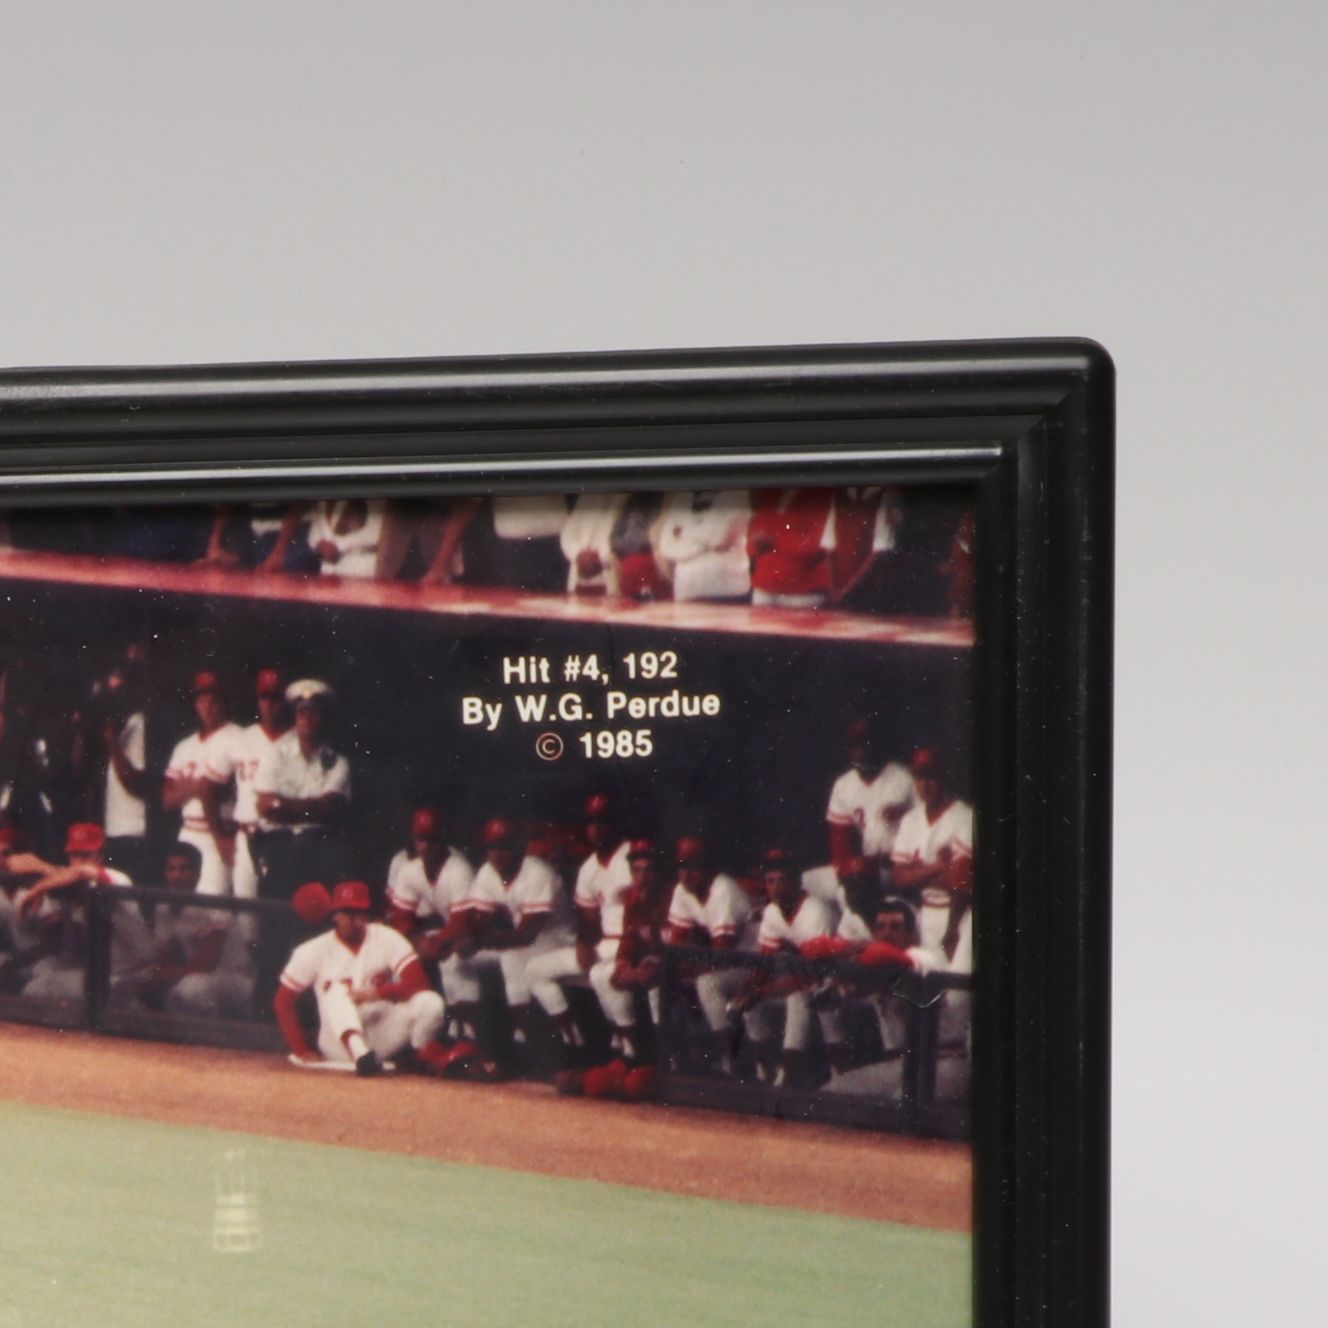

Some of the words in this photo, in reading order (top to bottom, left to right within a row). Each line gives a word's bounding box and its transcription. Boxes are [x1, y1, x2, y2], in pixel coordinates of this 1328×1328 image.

[502, 656, 551, 685] Hit
[563, 653, 609, 685] #4,
[622, 650, 678, 680] 192
[462, 696, 503, 731] By
[514, 692, 593, 723] W.G.
[606, 689, 721, 721] Perdue
[579, 729, 653, 759] 1985
